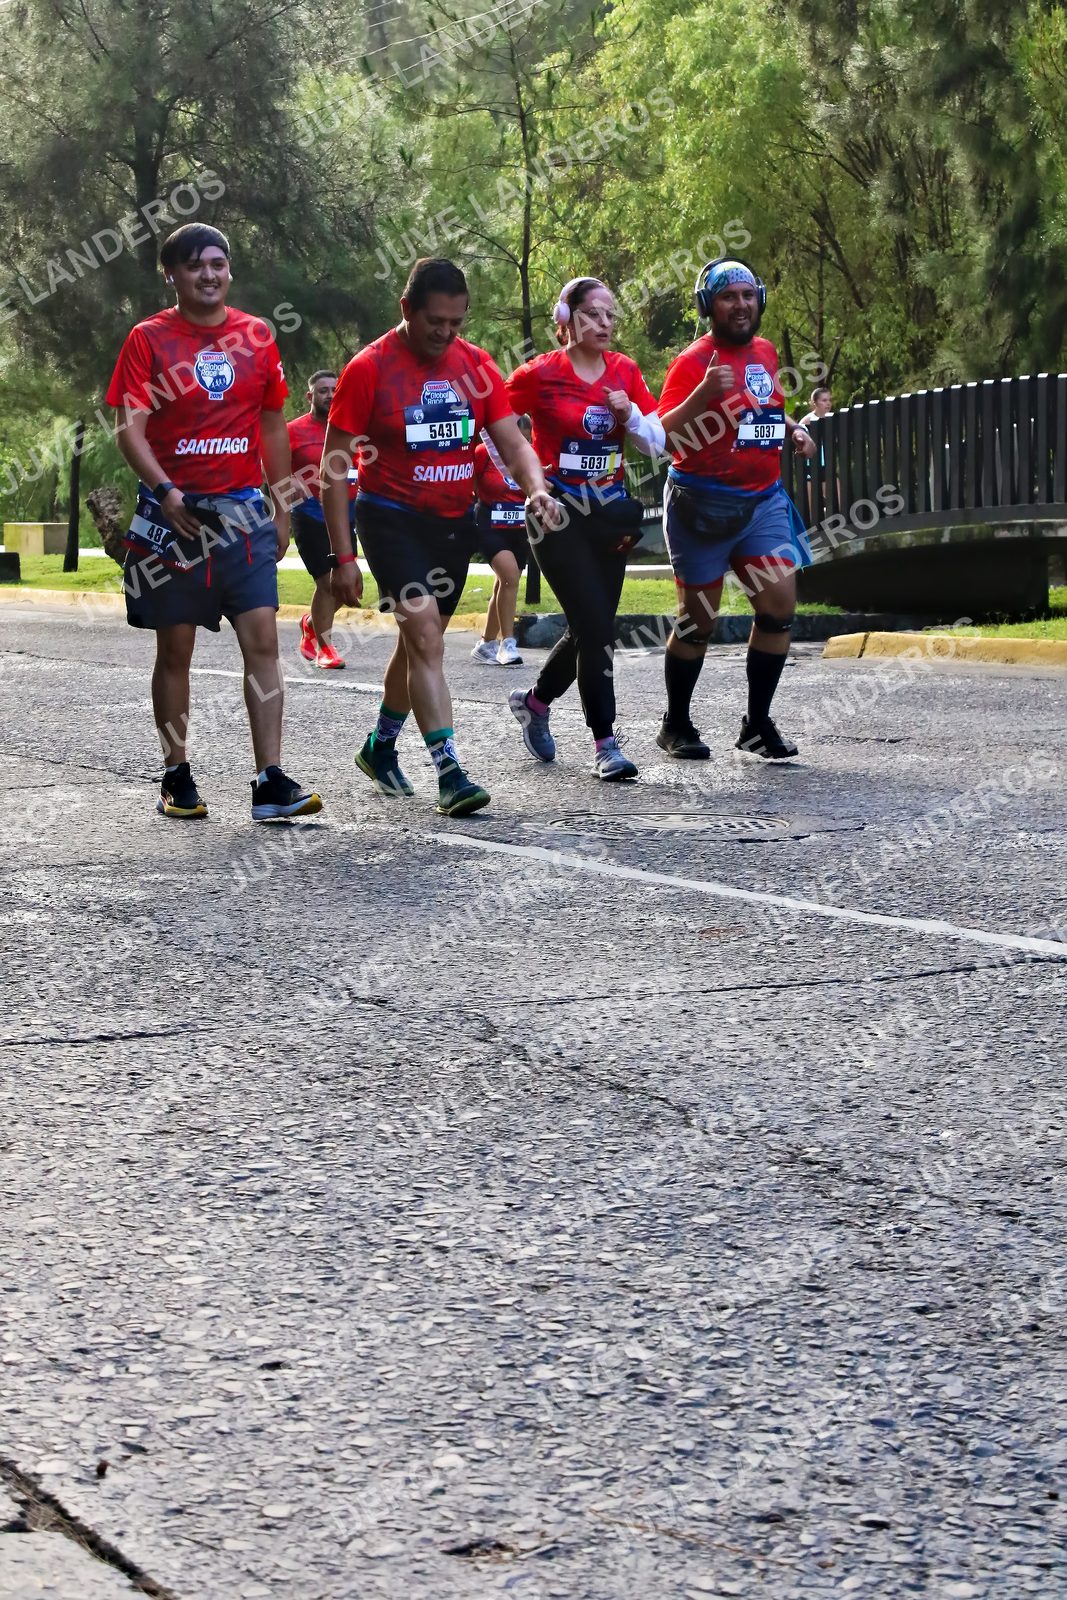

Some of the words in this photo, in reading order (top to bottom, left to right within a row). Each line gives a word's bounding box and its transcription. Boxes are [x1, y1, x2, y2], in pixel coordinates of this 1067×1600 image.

[429, 422, 458, 439] 5431
[754, 425, 775, 438] 5037
[174, 436, 249, 455] SANTIAGO
[581, 456, 607, 469] 5031
[412, 461, 474, 482] SANTIAGO
[503, 511, 520, 519] 4570
[146, 524, 164, 543] 48
